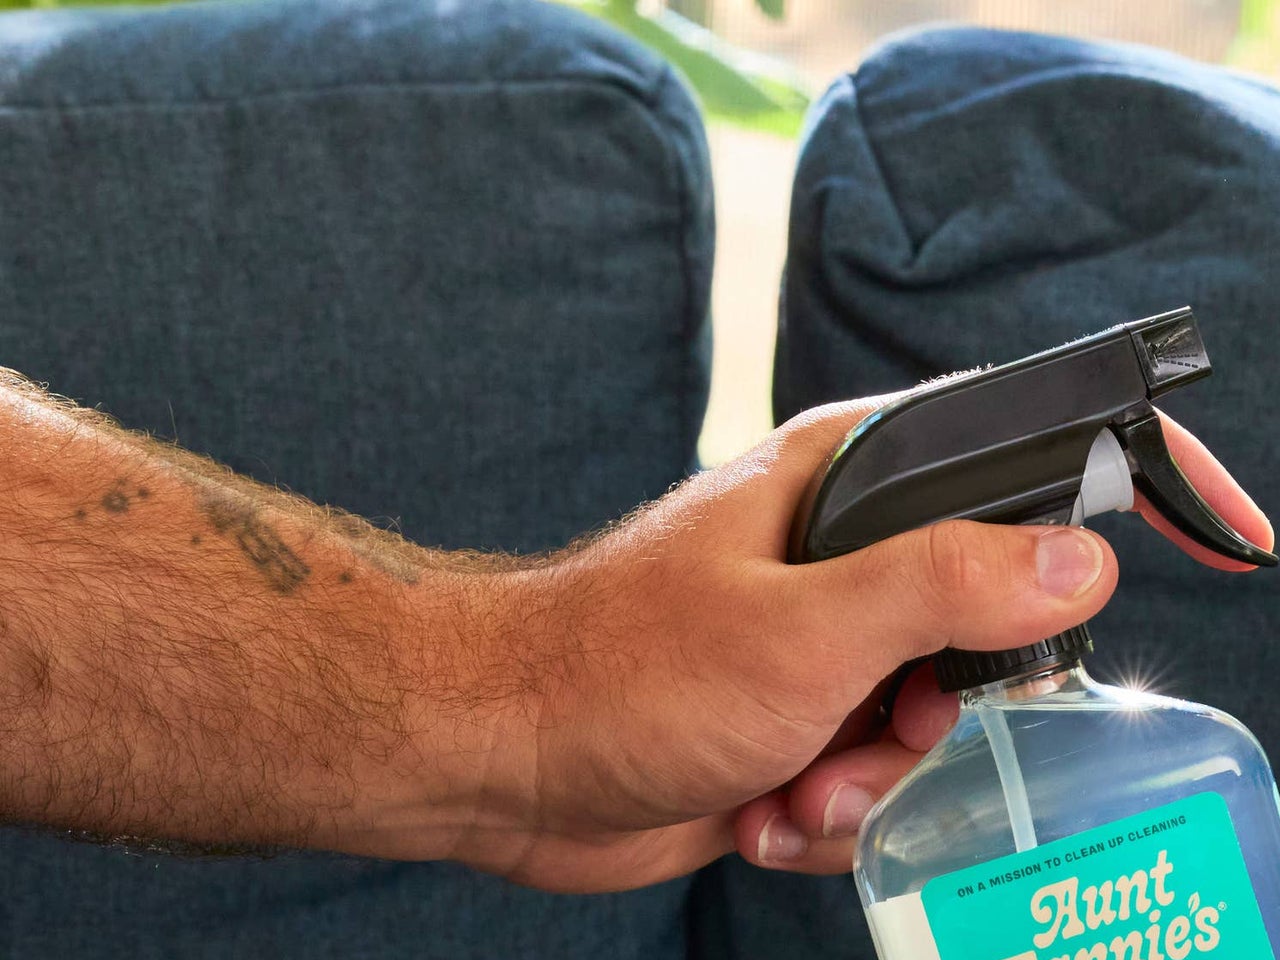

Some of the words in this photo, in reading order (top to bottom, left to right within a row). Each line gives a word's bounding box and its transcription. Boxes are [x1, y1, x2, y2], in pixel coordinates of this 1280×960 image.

[957, 886, 974, 898] ON
[978, 882, 986, 892] A
[989, 863, 1042, 887] MISSION
[1044, 857, 1061, 869] TO
[1065, 842, 1105, 863] CLEAN
[1109, 836, 1124, 849] UP
[1128, 815, 1186, 842] CLEANING
[1030, 849, 1175, 949] Aunt
